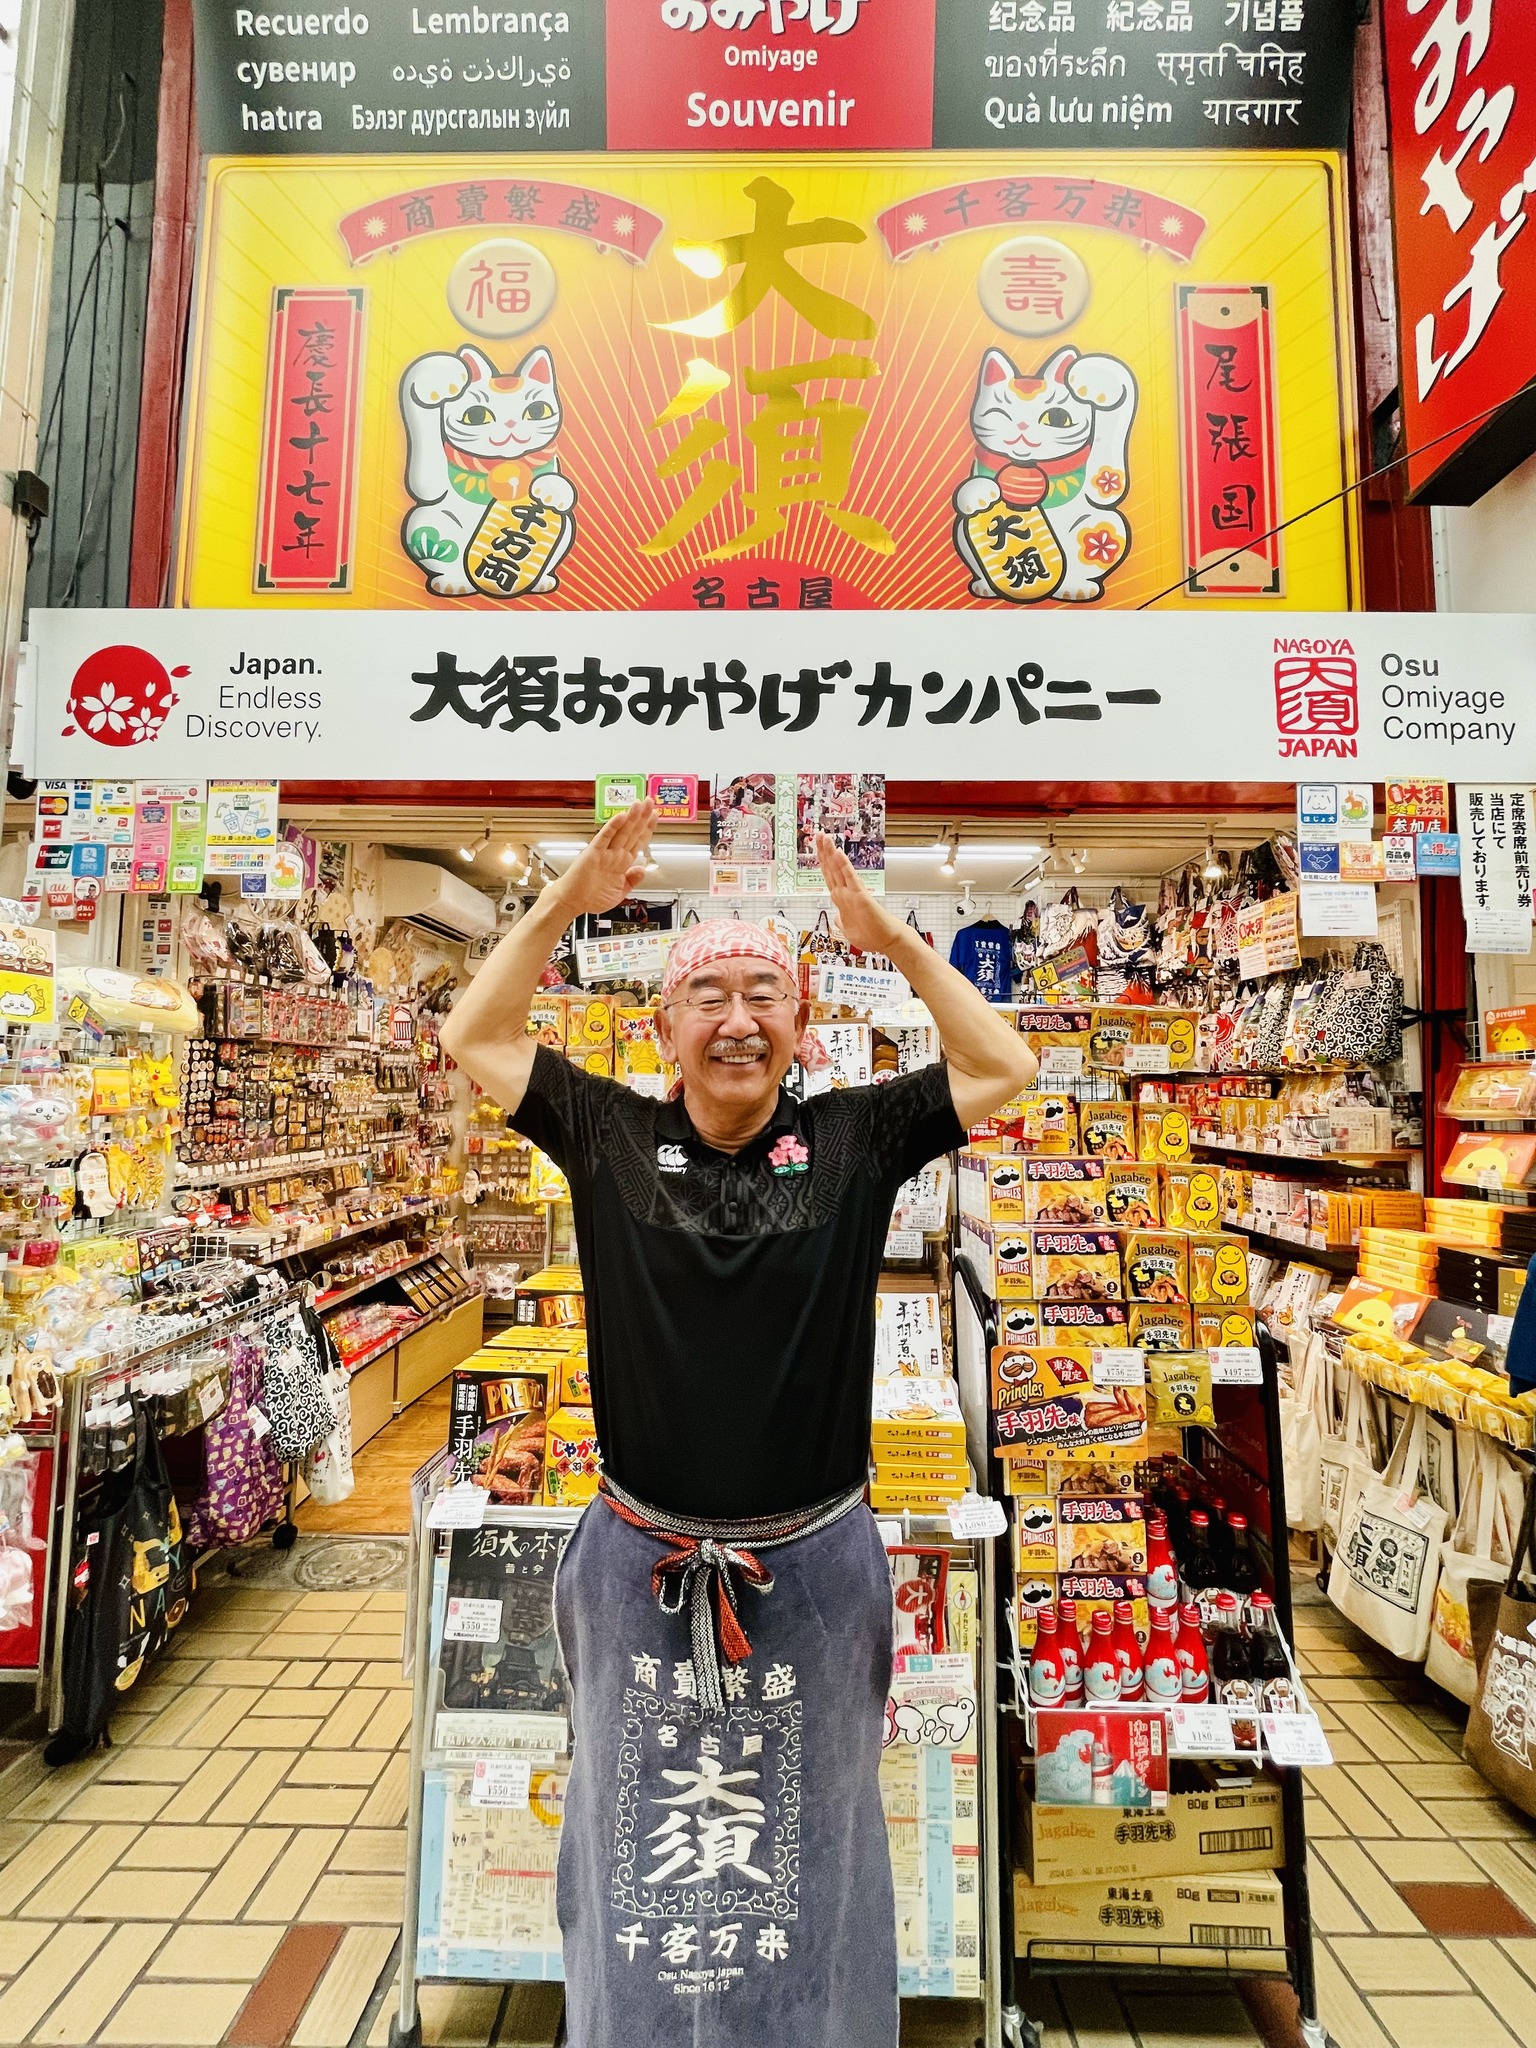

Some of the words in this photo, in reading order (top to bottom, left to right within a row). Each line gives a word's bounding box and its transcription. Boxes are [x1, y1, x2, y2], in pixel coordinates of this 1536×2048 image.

[236, 9, 369, 36] Recuerdo
[412, 7, 569, 41] Lembrança
[989, 0, 1075, 33] 纪念品
[1106, 0, 1193, 33] 紀念品
[1224, 0, 1305, 33] 기념품
[724, 45, 818, 72] Omiyage
[985, 38, 1126, 78] ของที่ระลึก
[236, 61, 356, 89] сувенир
[242, 103, 322, 131] hatıra
[352, 104, 406, 130] Бэлэг
[411, 107, 520, 135] дурсгалын
[525, 100, 570, 134] зүйл
[687, 90, 855, 128] Souvenir
[985, 92, 1040, 129] Quà
[1049, 97, 1093, 123] lưu
[1102, 93, 1173, 131] niệm
[1203, 99, 1302, 126] यादगार
[944, 181, 1143, 229] 千客万来
[466, 260, 531, 319] 福
[636, 176, 897, 561] 大須
[282, 320, 338, 560] 慶長十七年
[1204, 344, 1257, 535] 尾張国
[986, 513, 1050, 588] 大須
[691, 576, 834, 610] 名古屋
[1274, 638, 1355, 655] NAGOYA
[230, 652, 322, 680] Japan.
[1381, 654, 1439, 676] Osu
[219, 685, 321, 710] Endless
[410, 651, 1161, 733] 大須おみやげカンパニー
[1382, 685, 1505, 714] Omiyage
[187, 715, 322, 743] Discovery.
[1383, 716, 1516, 745] Company
[1278, 738, 1358, 758] JAPAN
[45, 781, 67, 789] VISA
[1405, 785, 1444, 805] 大須
[1392, 818, 1442, 833] 参加店
[1490, 793, 1507, 849] 当店にて
[717, 829, 733, 838] 14
[744, 829, 759, 838] 15
[1352, 854, 1371, 862] 大須
[1510, 793, 1532, 907] 定席寄席前売り券
[51, 895, 68, 903] PAY
[977, 958, 995, 983] 大須
[531, 1002, 561, 1011] agabee
[1020, 1013, 1072, 1031] 手羽先味
[1097, 1016, 1136, 1028] Jagabee
[1102, 1029, 1130, 1039] 手羽先味
[1088, 1110, 1128, 1122] Jagabee
[1094, 1123, 1123, 1133] 手羽先味
[1028, 1162, 1084, 1179] 手羽先味
[1109, 1172, 1151, 1184] Jagabee
[992, 1187, 1022, 1200] PRINGLES
[1115, 1186, 1146, 1196] 手羽先味
[1037, 1234, 1096, 1252] 手羽先味
[1135, 1244, 1181, 1258] Jagabee
[998, 1260, 1029, 1275] PRINGLES
[1141, 1259, 1174, 1270] 手羽先味
[1045, 1306, 1104, 1324] 手羽先味
[1138, 1315, 1184, 1328] Jagabee
[1005, 1332, 1037, 1346] PRINGLES
[1145, 1330, 1178, 1340] 手羽先味
[1053, 1359, 1075, 1372] 東海
[1061, 1369, 1083, 1381] 限定
[1164, 1371, 1201, 1383] Jagabee
[998, 1382, 1044, 1410] Pringles
[997, 1404, 1082, 1437] 手羽先味
[452, 1414, 475, 1484] 手羽先
[1062, 1501, 1123, 1521] 手羽先味
[1022, 1530, 1054, 1546] PRINGLES
[505, 1563, 544, 1575] 昔と今
[1062, 1577, 1124, 1597] 手羽先味
[488, 1785, 509, 1796] ¥550
[1188, 1800, 1209, 1811] 80g
[641, 1756, 773, 1884] 大須
[1038, 1821, 1096, 1841] Jagabee
[1115, 1820, 1176, 1844] 手羽先味
[1107, 1887, 1153, 1902] 東海土産
[1177, 1888, 1200, 1901] 80g
[1100, 1905, 1164, 1929] 手羽先味
[616, 1922, 789, 1964] 千客万来
[658, 1971, 677, 1981] Osu
[716, 1966, 744, 1980] Japan
[673, 1983, 700, 1995] Since
[702, 1980, 730, 1993] 1612
